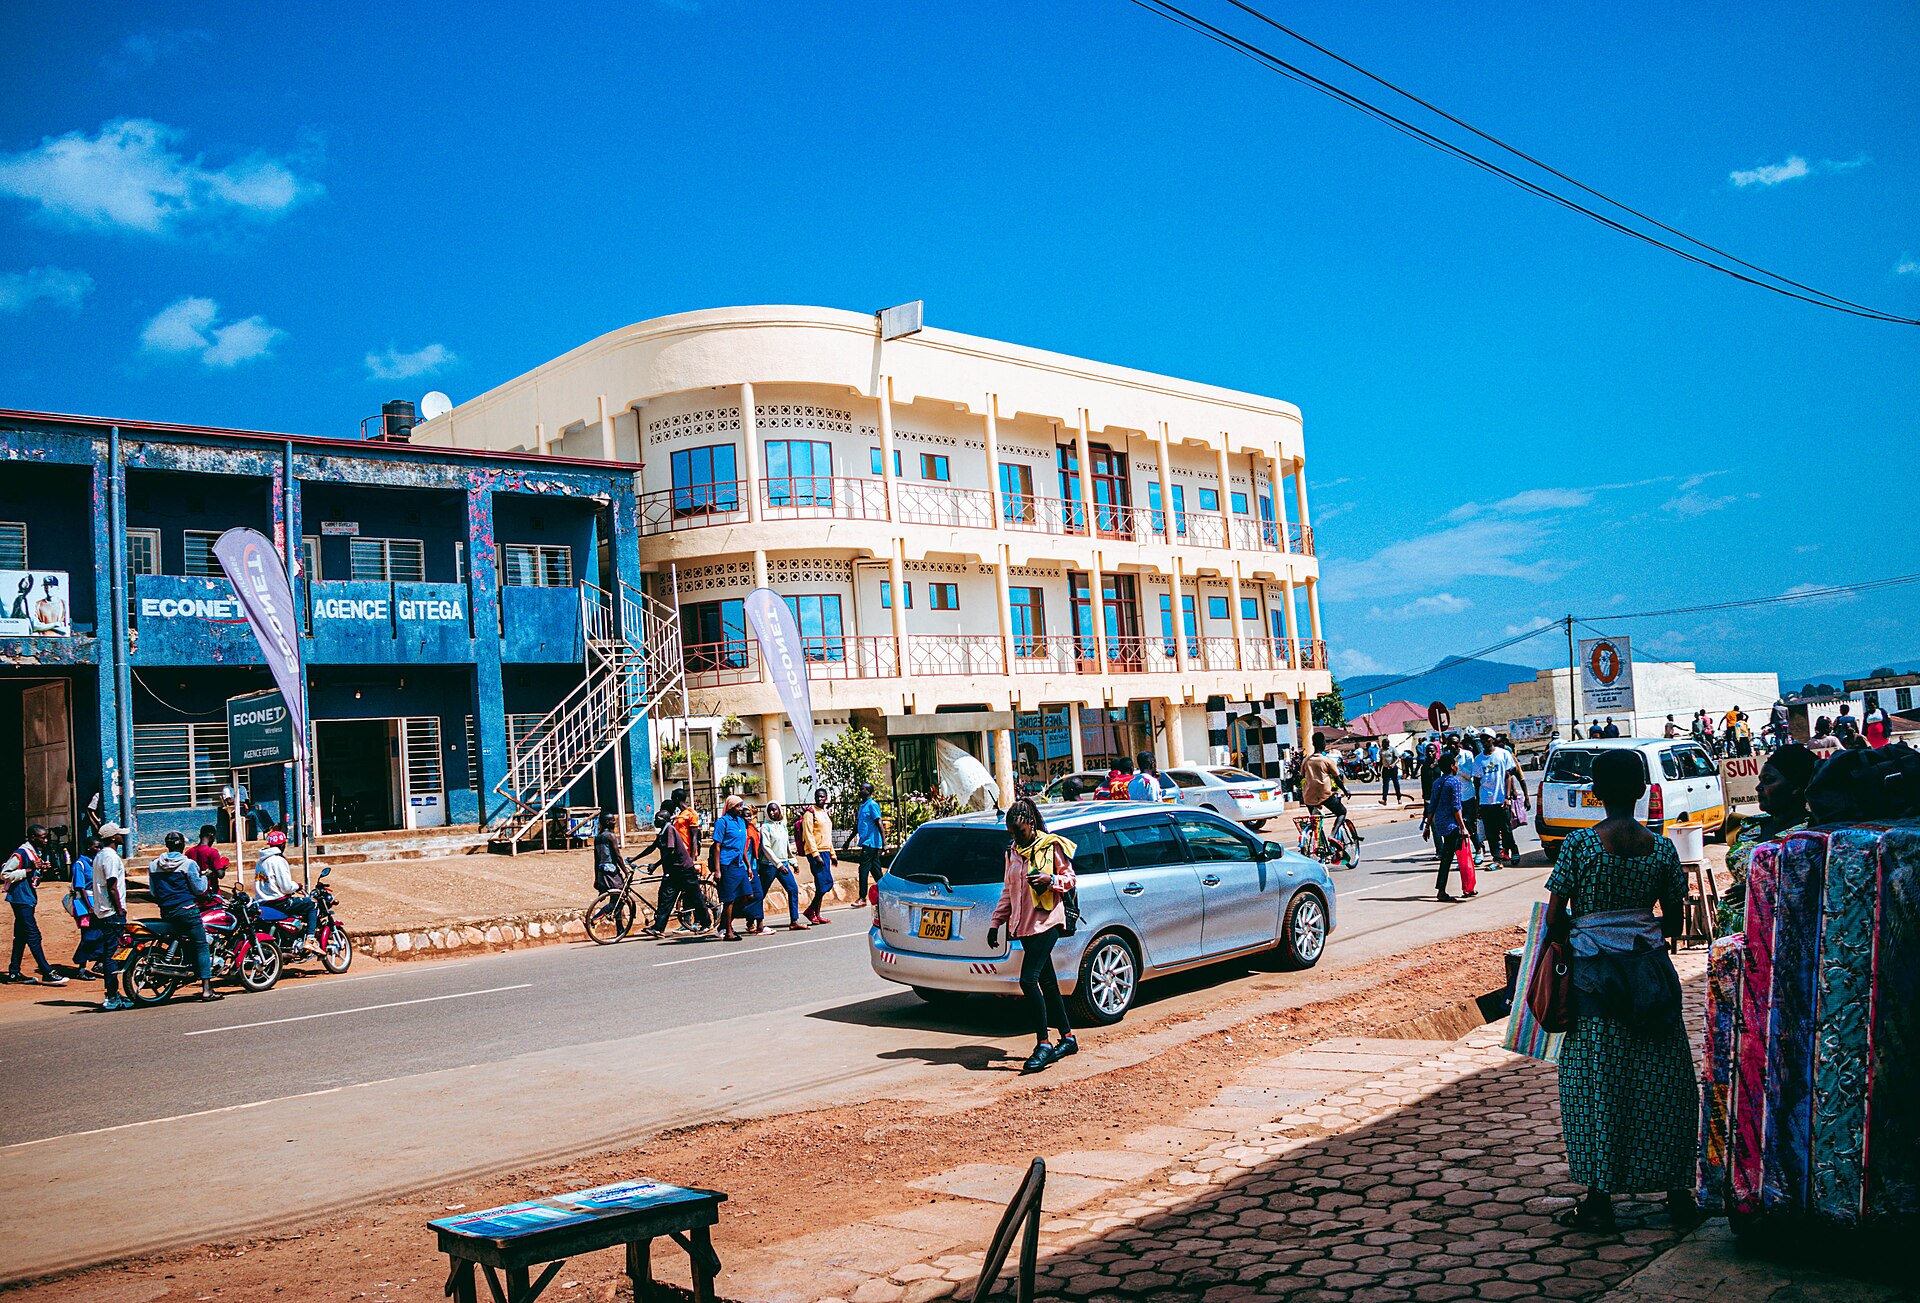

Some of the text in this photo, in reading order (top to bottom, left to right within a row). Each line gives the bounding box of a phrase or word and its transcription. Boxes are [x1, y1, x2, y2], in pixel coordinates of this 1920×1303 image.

[314, 600, 463, 620] AGENCE GITEGA
[233, 706, 282, 727] ECONET
[244, 746, 279, 759] AGENCE GITEGA
[1726, 759, 1758, 777] SUN
[925, 924, 946, 937] 0985
